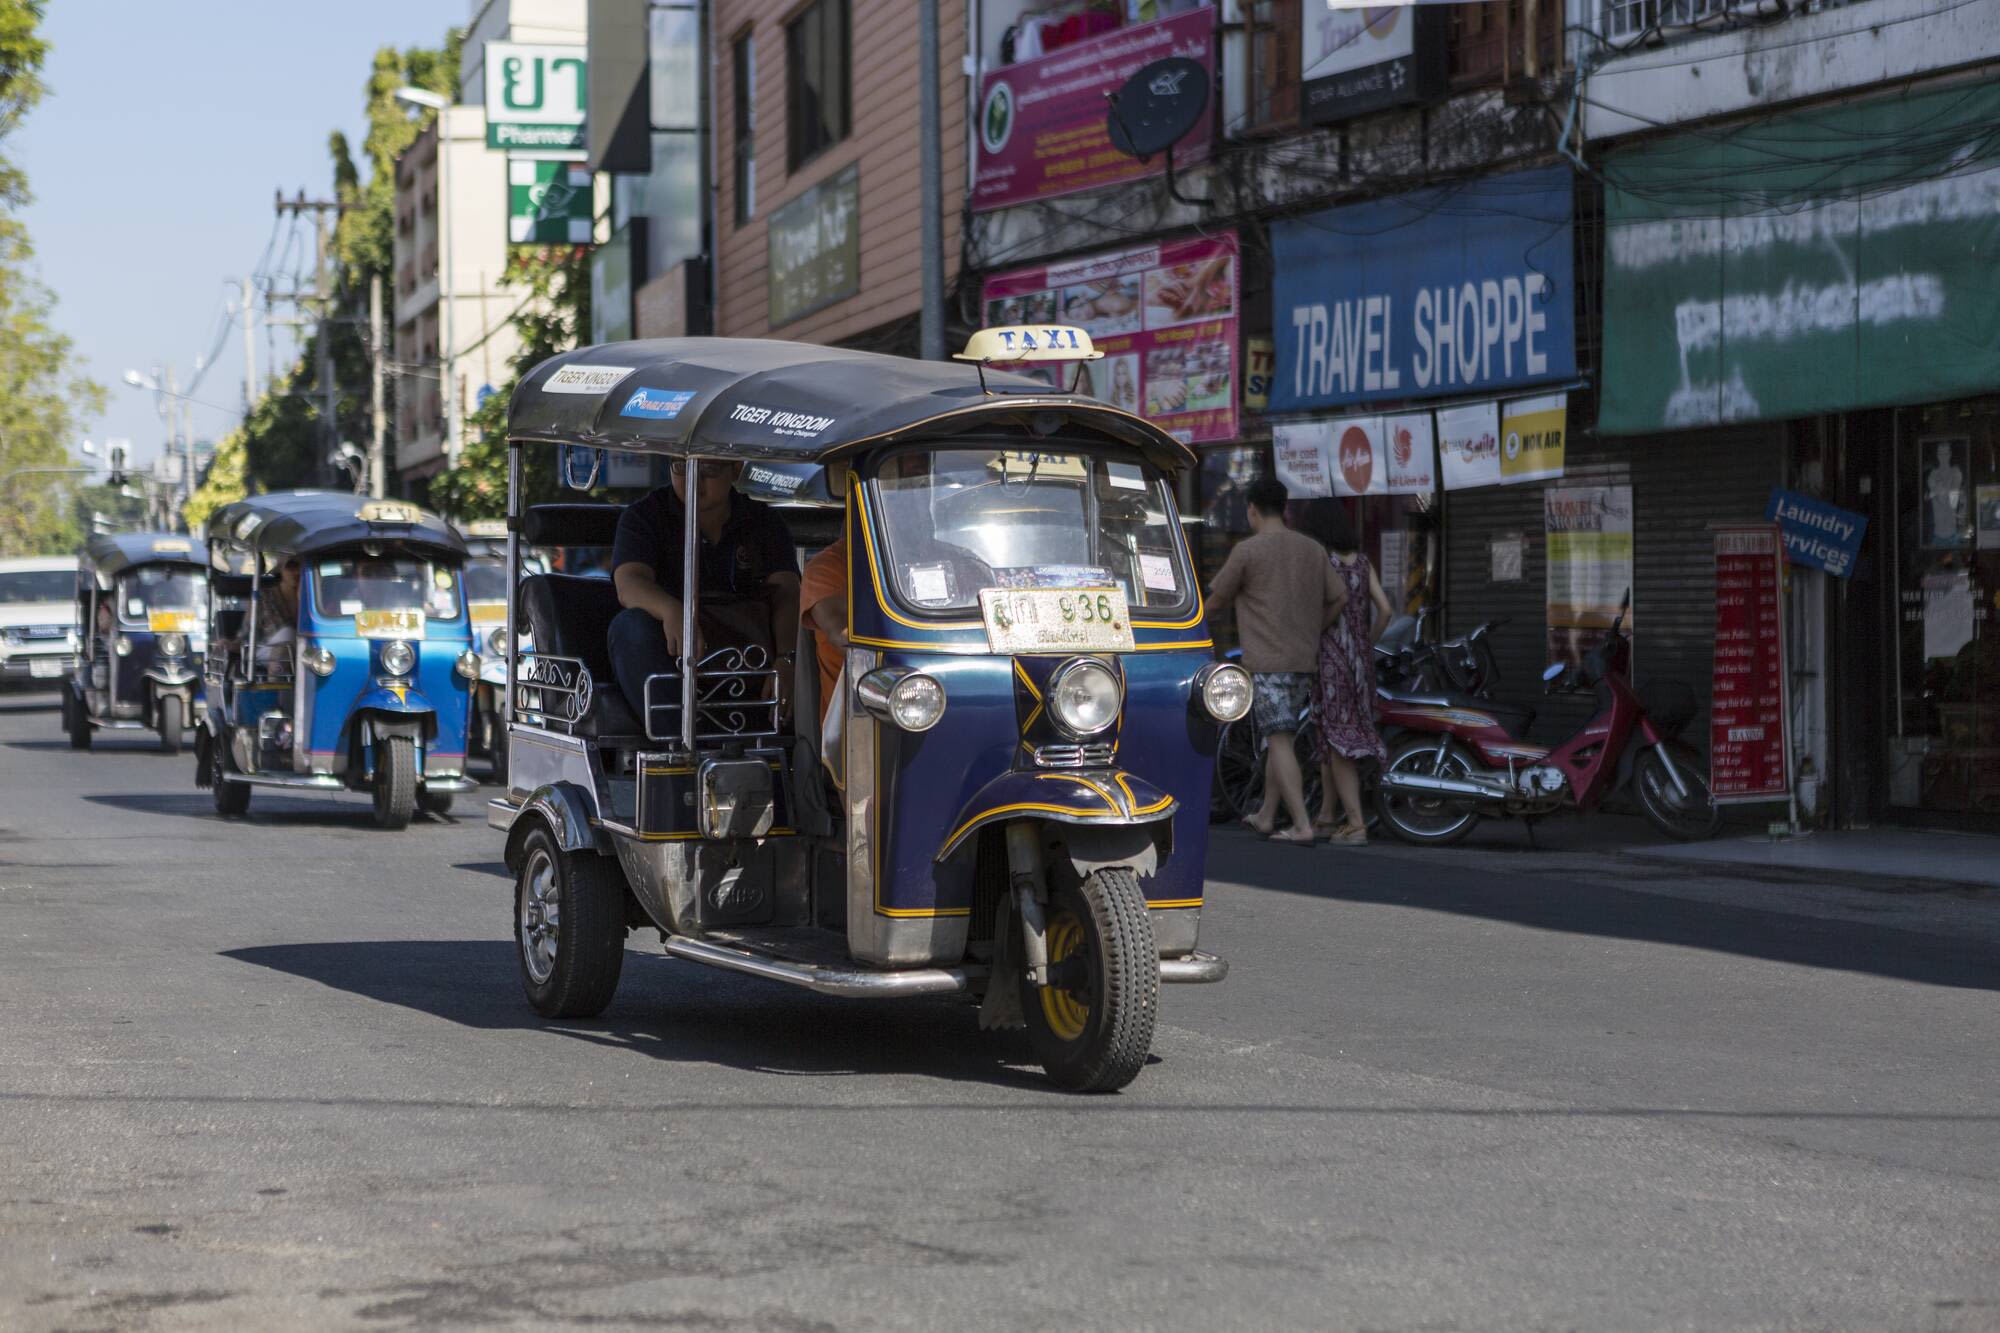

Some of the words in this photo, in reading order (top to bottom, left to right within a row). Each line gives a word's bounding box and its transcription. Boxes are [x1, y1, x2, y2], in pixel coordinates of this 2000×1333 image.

[503, 57, 586, 112] ยา
[998, 329, 1080, 350] TAXI
[1293, 296, 1399, 397] TRAVEL
[1413, 273, 1547, 388] SHOPPE
[553, 371, 586, 384] TIGER
[730, 404, 771, 424] TIGER
[768, 411, 835, 431] KINGDOM
[1462, 435, 1498, 463] Smile
[1522, 433, 1542, 451] NOK
[1543, 430, 1562, 449] AIR
[1279, 449, 1298, 461] Low
[1298, 447, 1318, 460] cost
[1287, 461, 1320, 473] Airlines
[749, 467, 773, 485] TIGER
[769, 472, 803, 489] KINGDOM
[1300, 473, 1323, 486] Ticket
[1546, 499, 1594, 516] TRAVEL
[1549, 513, 1601, 530] SHOPPE
[1775, 496, 1855, 541] Laundry
[1781, 531, 1851, 566] ervices
[1058, 594, 1113, 625] 936
